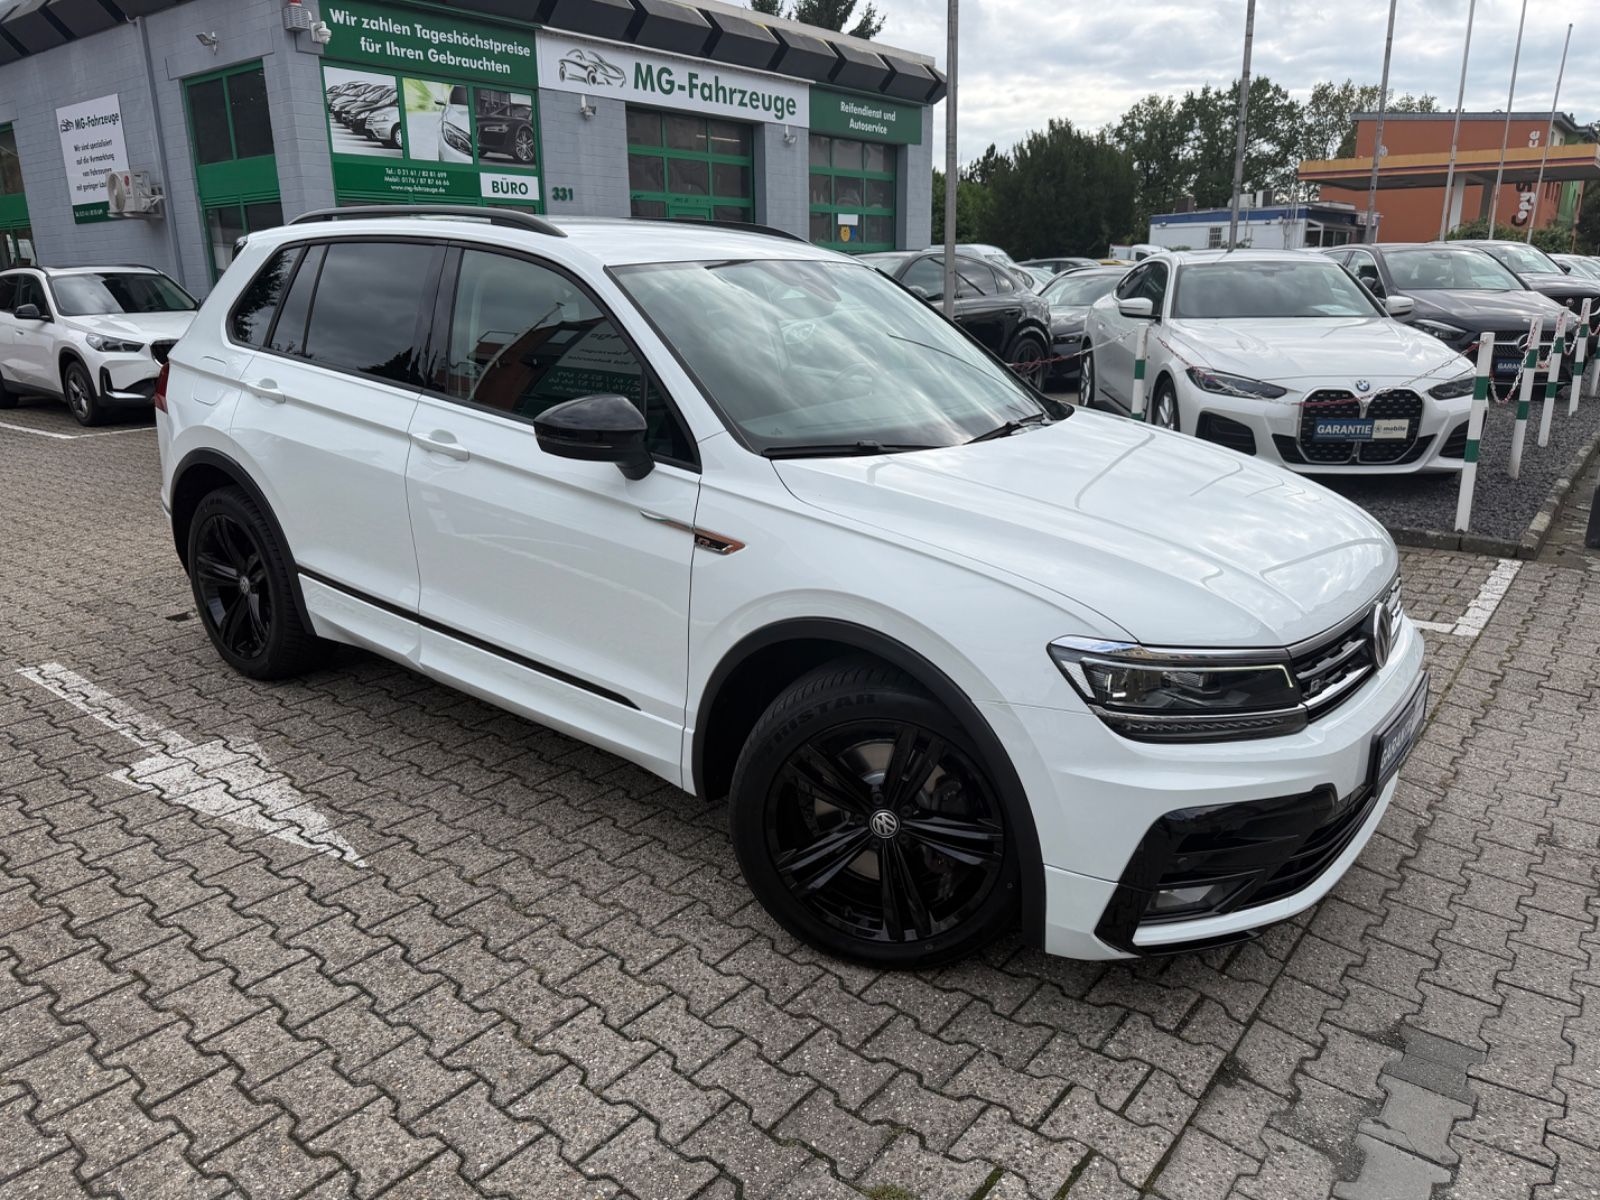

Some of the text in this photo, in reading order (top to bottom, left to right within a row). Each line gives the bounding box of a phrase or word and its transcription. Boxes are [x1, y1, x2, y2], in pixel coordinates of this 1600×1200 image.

[329, 8, 531, 57] Wir zahlen Tageshöchstpreise
[360, 37, 511, 74] für Ihren Gebrauchten
[633, 62, 797, 120] MG-Fahrzeuge
[840, 101, 896, 121] Reifendienst und
[74, 113, 119, 130] MG-Fahrzeuge
[848, 118, 888, 135] Autoservice
[491, 177, 529, 196] BÜRO
[551, 186, 574, 201] 331
[1316, 424, 1373, 435] GARANTIE
